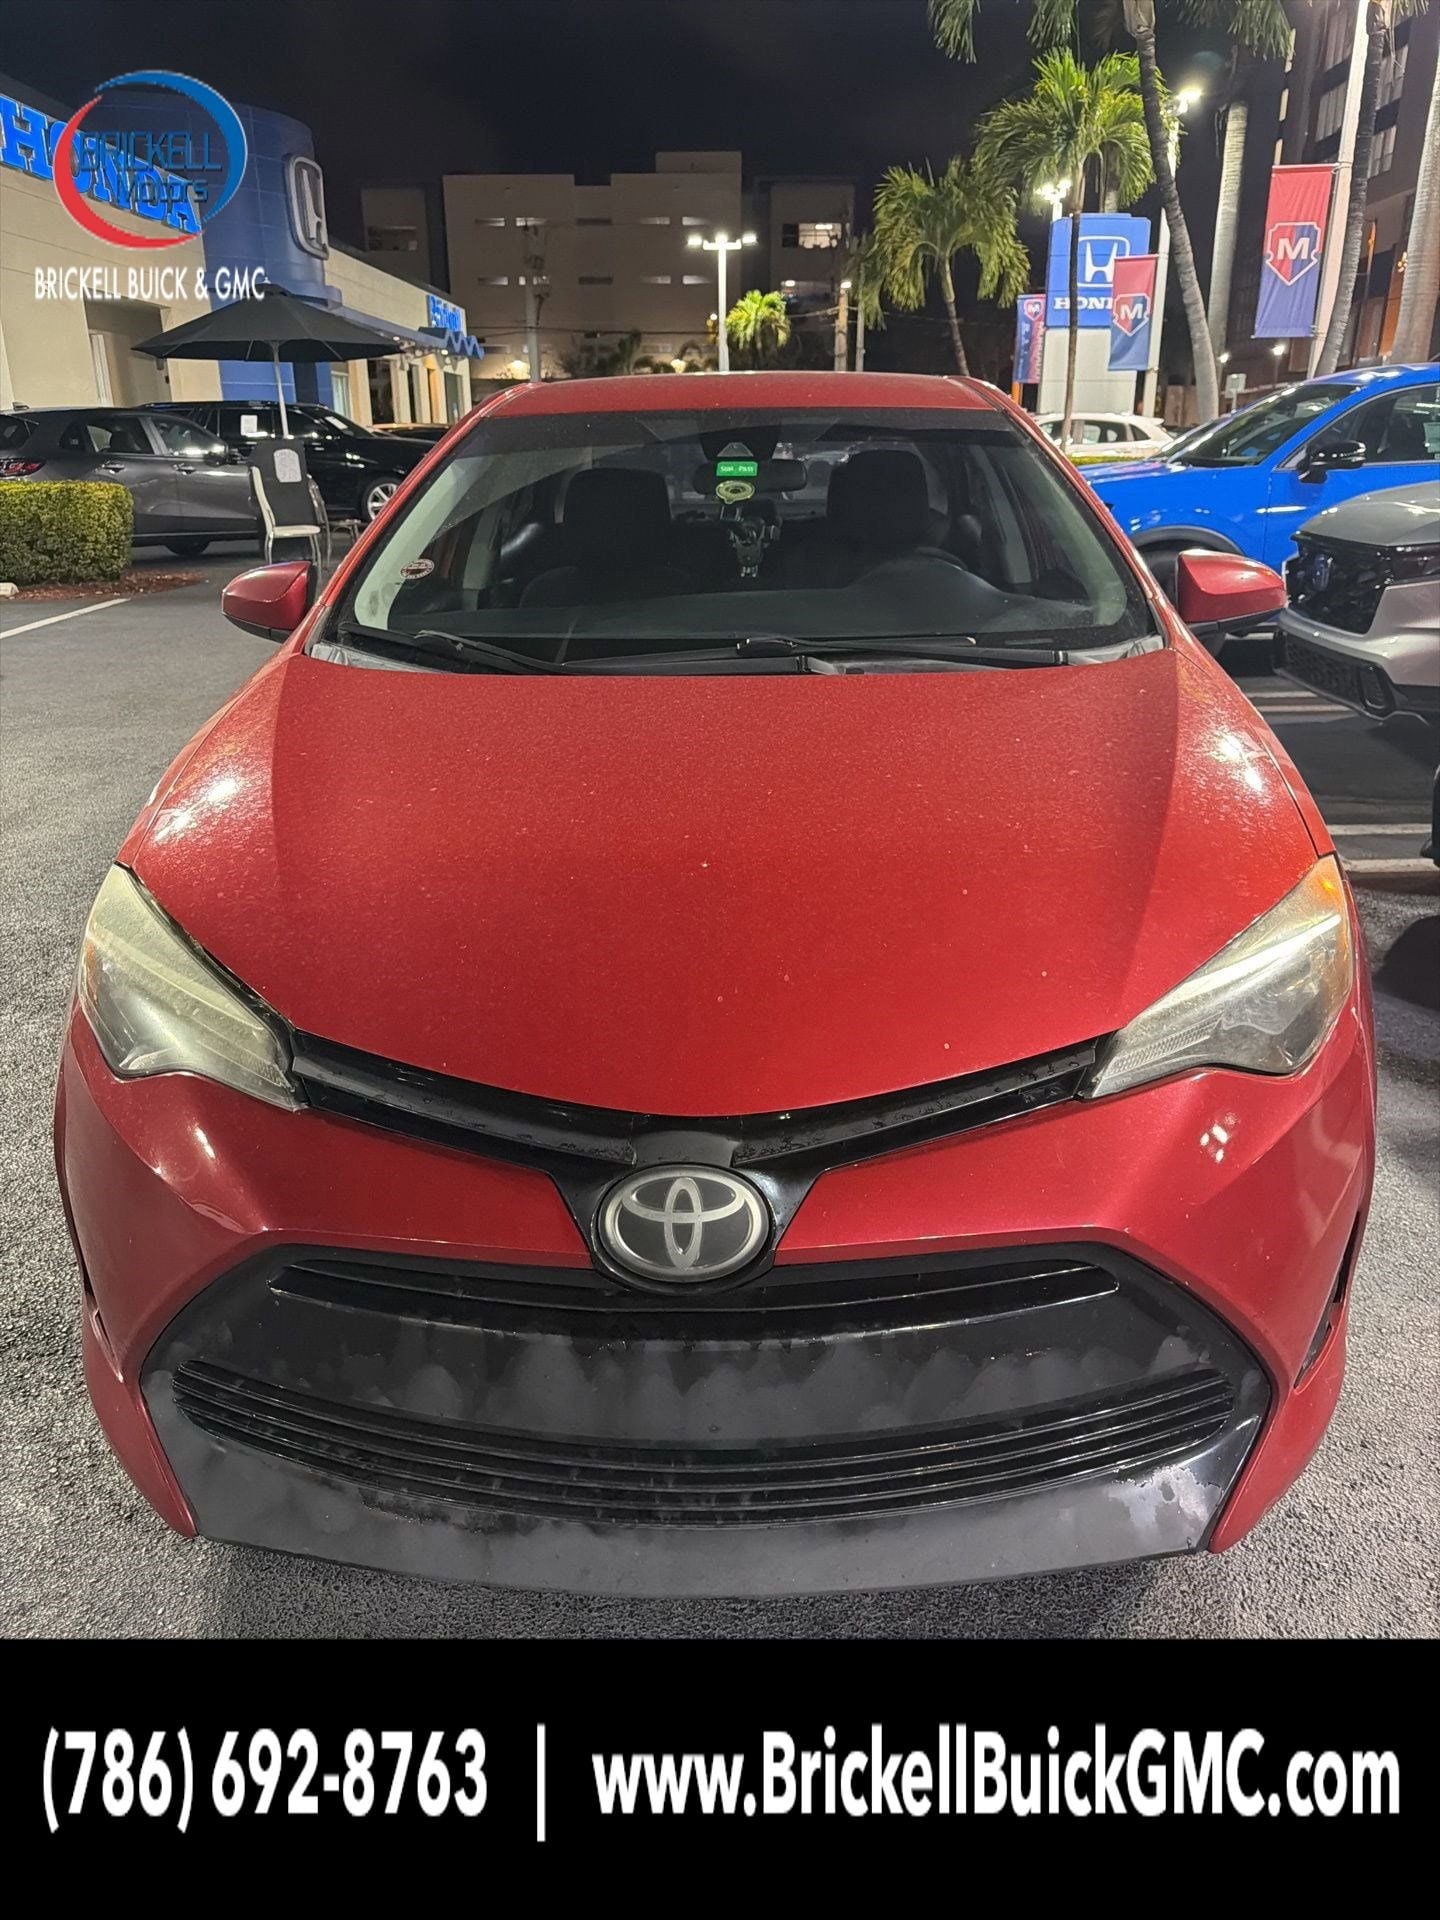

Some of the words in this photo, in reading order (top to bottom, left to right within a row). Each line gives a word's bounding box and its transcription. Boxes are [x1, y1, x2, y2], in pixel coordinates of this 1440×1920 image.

[0, 93, 202, 234] HONDA
[1277, 237, 1310, 260] M
[1053, 296, 1113, 310] HON
[1120, 303, 1143, 321] M
